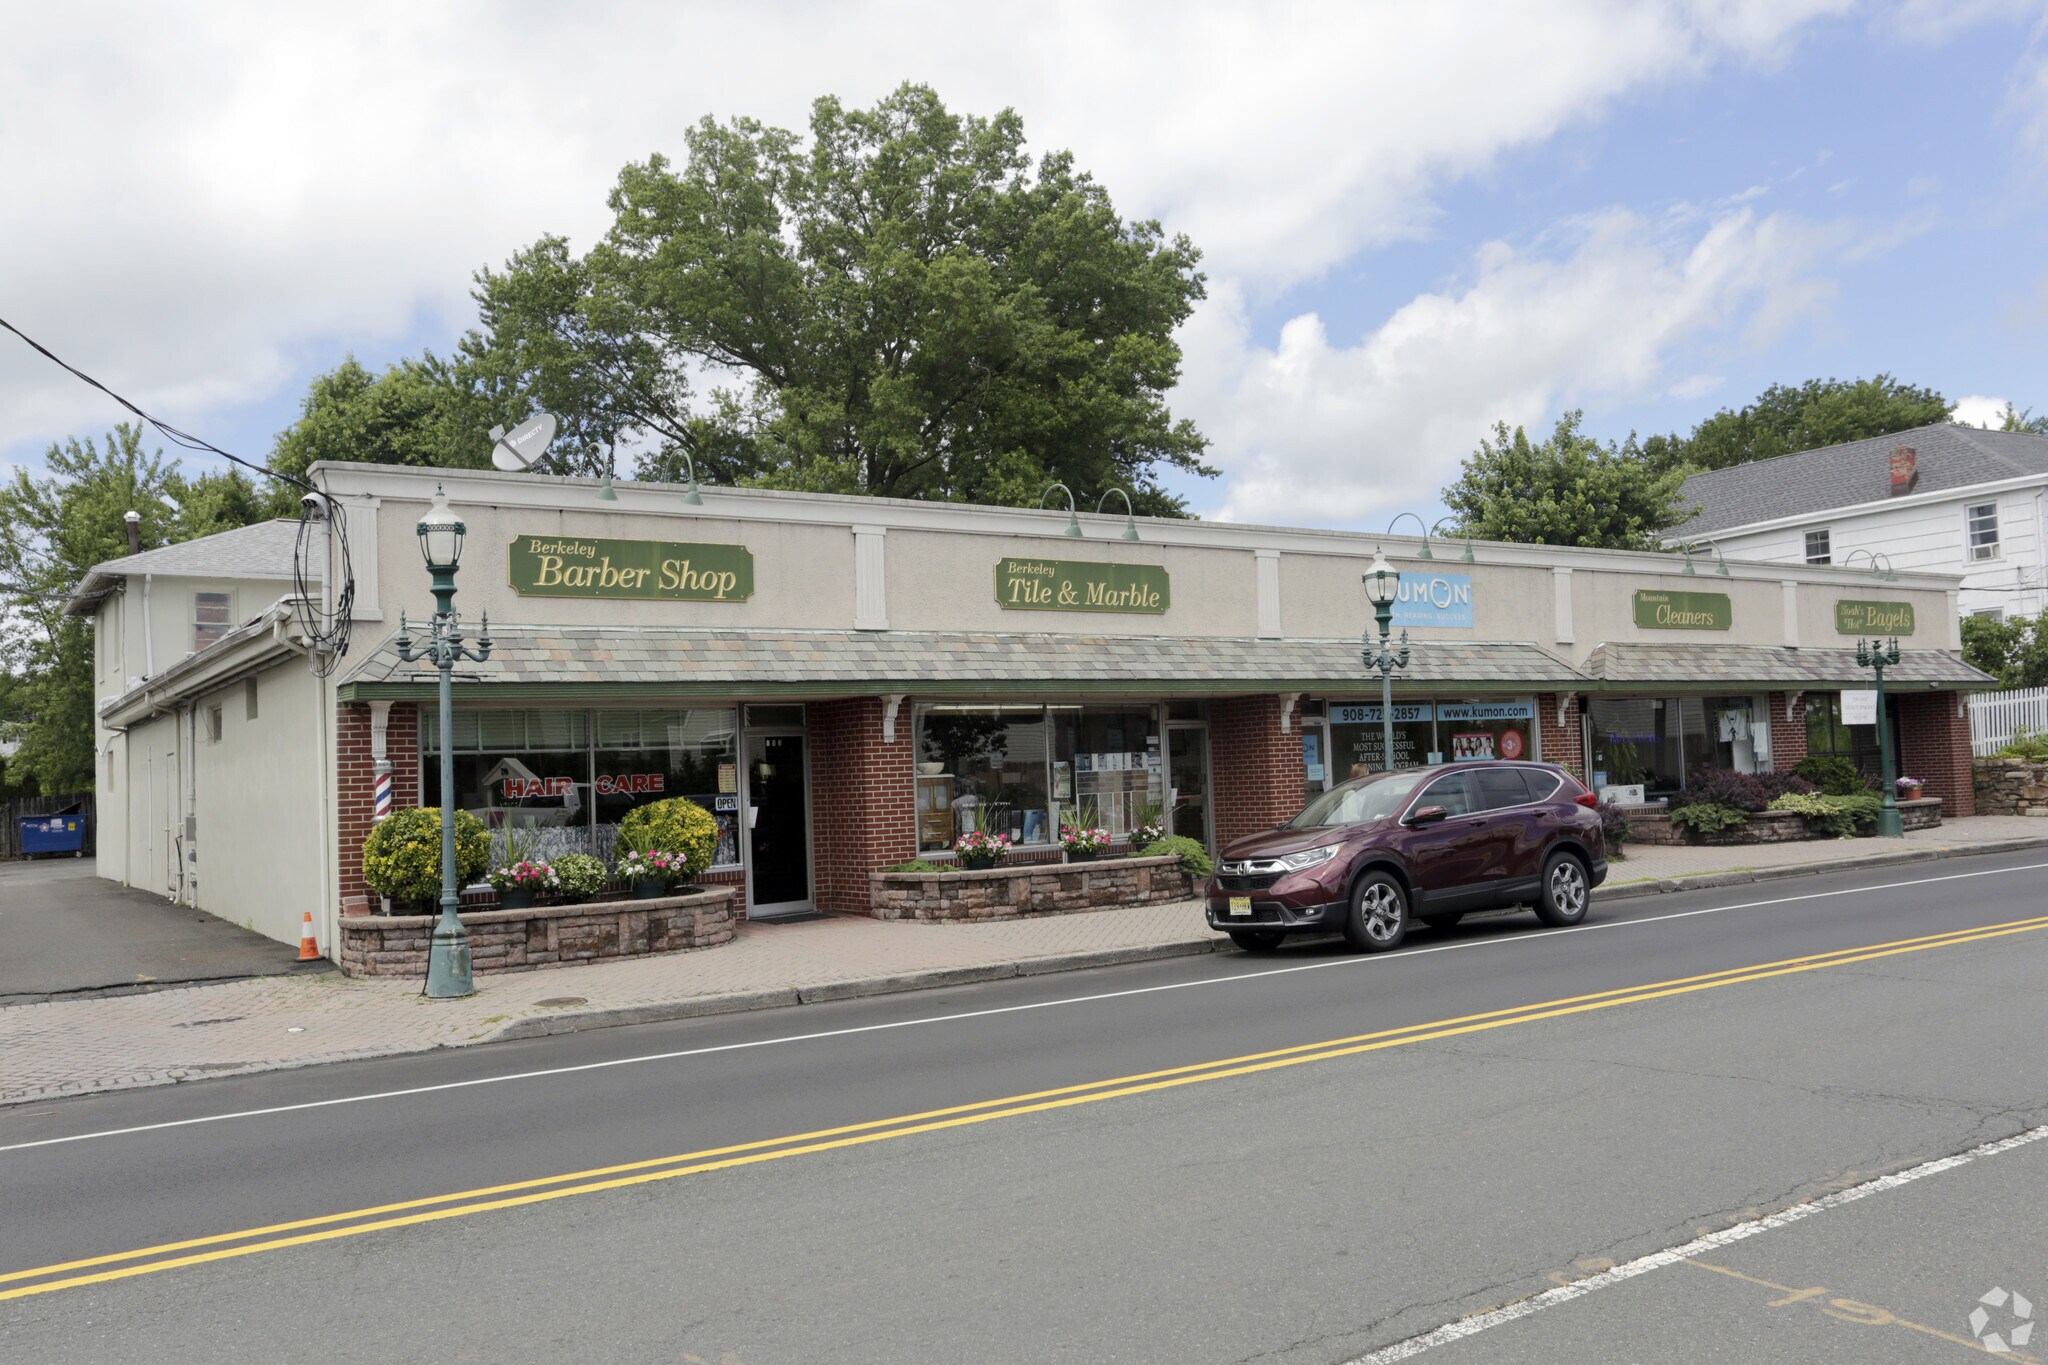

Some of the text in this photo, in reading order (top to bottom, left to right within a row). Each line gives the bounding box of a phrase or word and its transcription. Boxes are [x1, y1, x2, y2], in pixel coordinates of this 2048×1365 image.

[517, 424, 543, 444] DIRECTV
[528, 540, 596, 558] Berkeley
[532, 555, 737, 599] Barber Shop
[1007, 561, 1055, 577] Berkeley
[1008, 577, 1160, 608] Tile & Marble
[1397, 578, 1468, 609] UMON
[1640, 593, 1669, 602] Mountain
[1656, 604, 1714, 625] Cleaners
[1840, 604, 1864, 616] Noah's
[1866, 606, 1911, 632] Bagels
[1342, 707, 1420, 721] 908-72-2857
[1443, 706, 1528, 718] www.kumon.com
[1360, 731, 1407, 740] THE WLD'S
[1353, 741, 1415, 751] MOST SUCESSFUL
[1359, 752, 1410, 761] AFTER-SHOOL
[503, 773, 664, 798] HAIR CARE
[717, 798, 736, 809] OPEN
